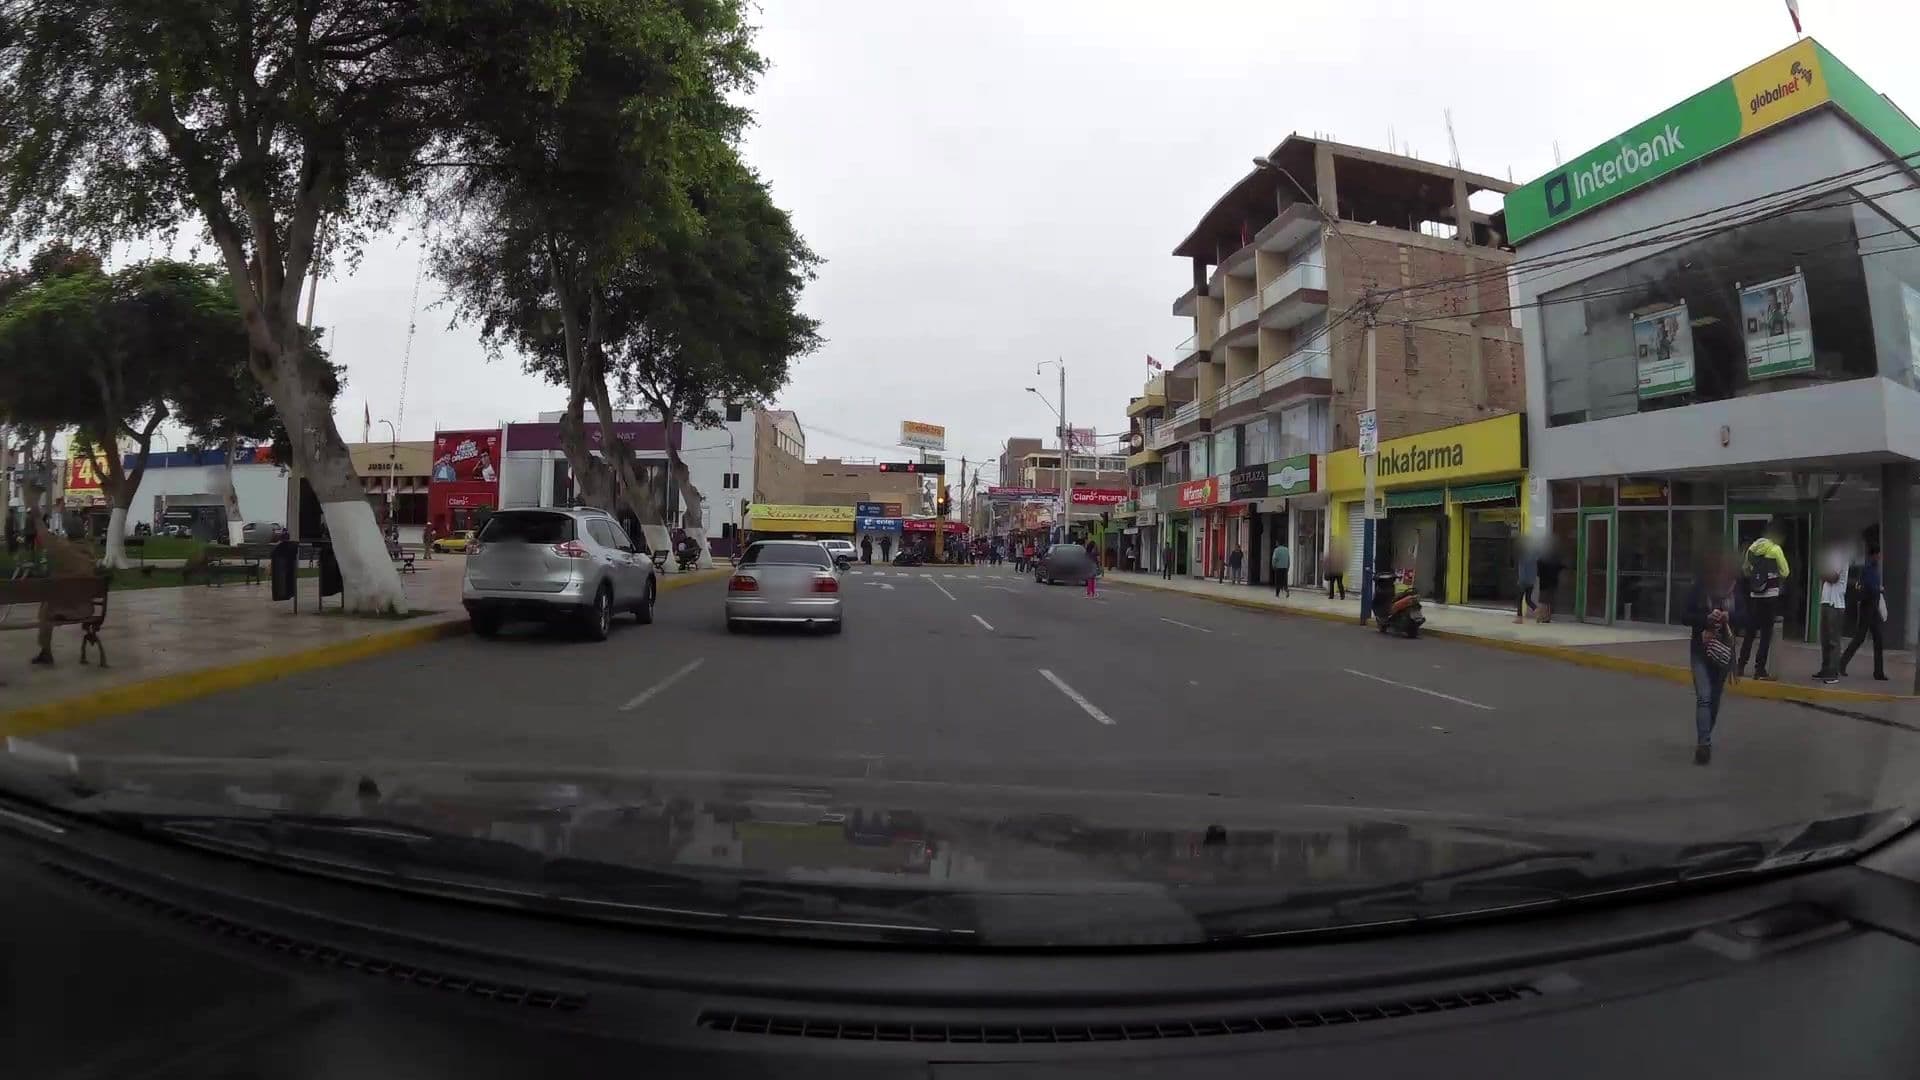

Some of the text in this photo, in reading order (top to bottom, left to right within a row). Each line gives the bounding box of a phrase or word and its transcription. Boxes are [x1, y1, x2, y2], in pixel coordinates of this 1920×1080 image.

[1749, 75, 1801, 115] globalnet
[1573, 123, 1685, 199] Interbank
[367, 463, 404, 471] JUDICAL
[1378, 442, 1464, 477] Inkafarma
[448, 496, 467, 506] Claro
[1073, 492, 1095, 501] Claro
